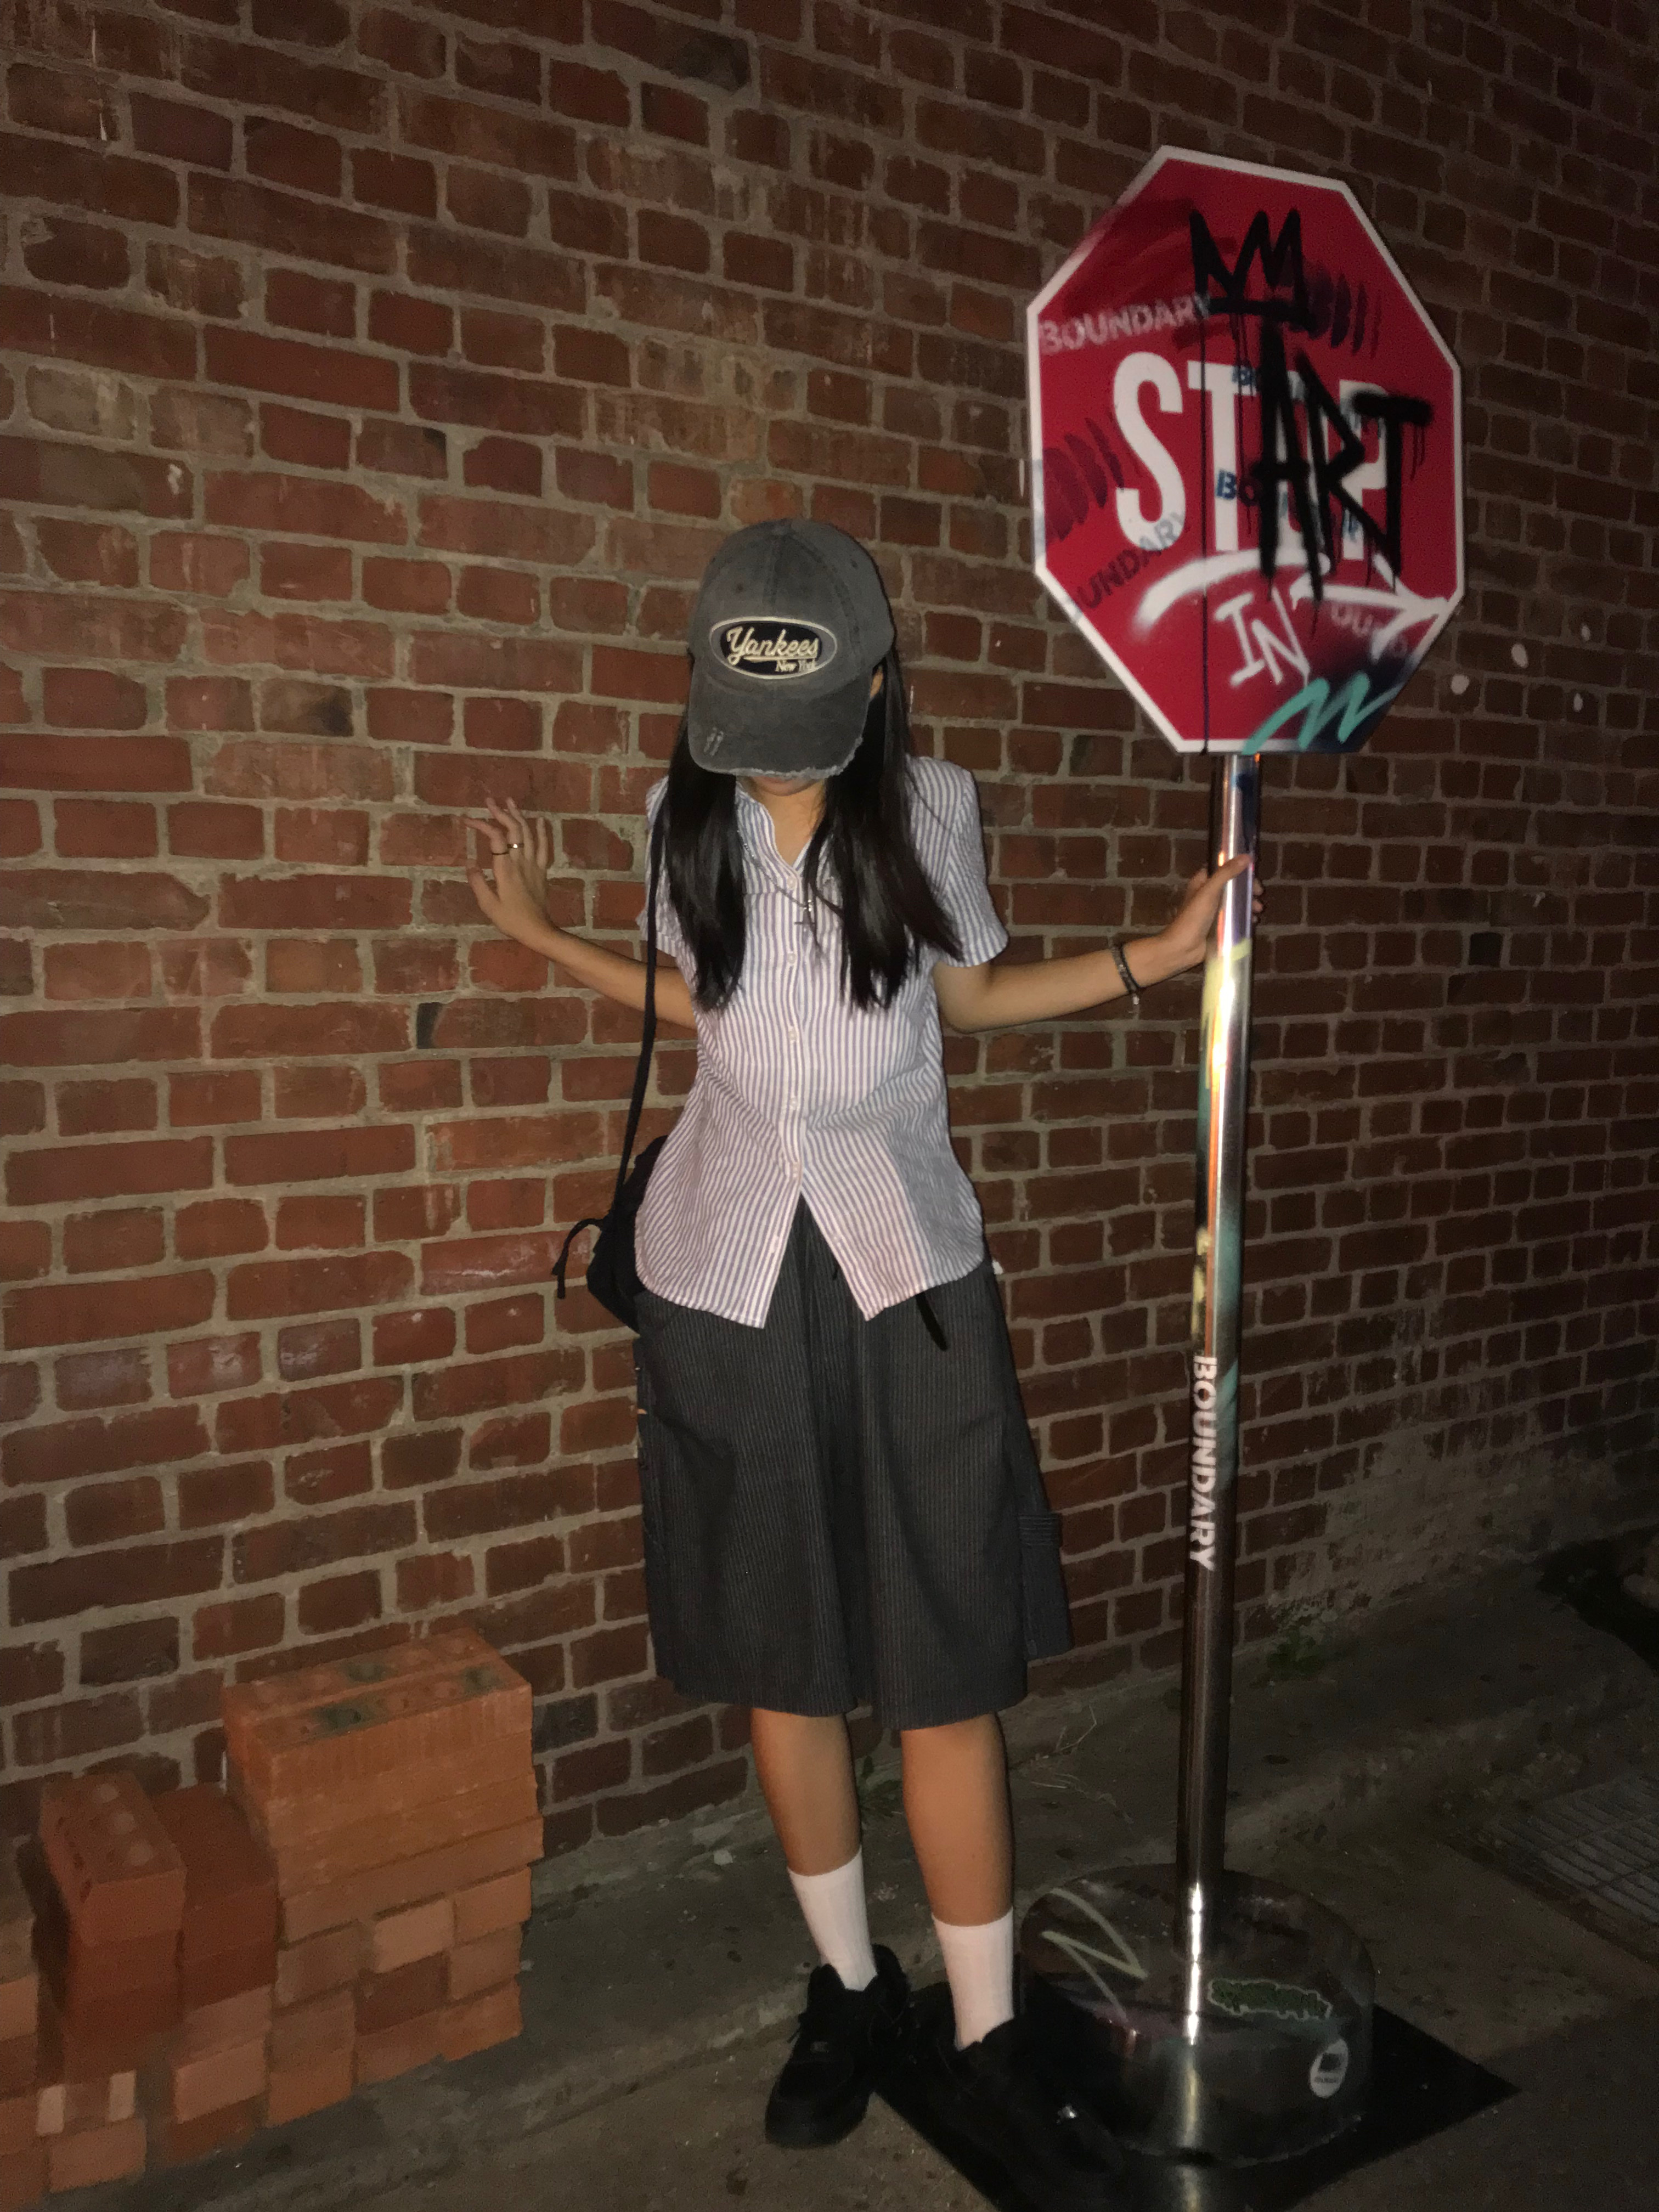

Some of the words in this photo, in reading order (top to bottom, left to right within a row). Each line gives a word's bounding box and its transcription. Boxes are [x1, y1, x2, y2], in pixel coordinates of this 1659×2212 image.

[726, 626, 819, 665] Yankees
[775, 659, 797, 673] New
[1214, 586, 1311, 689] IN
[1190, 1356, 1217, 1571] BOUNDARY
